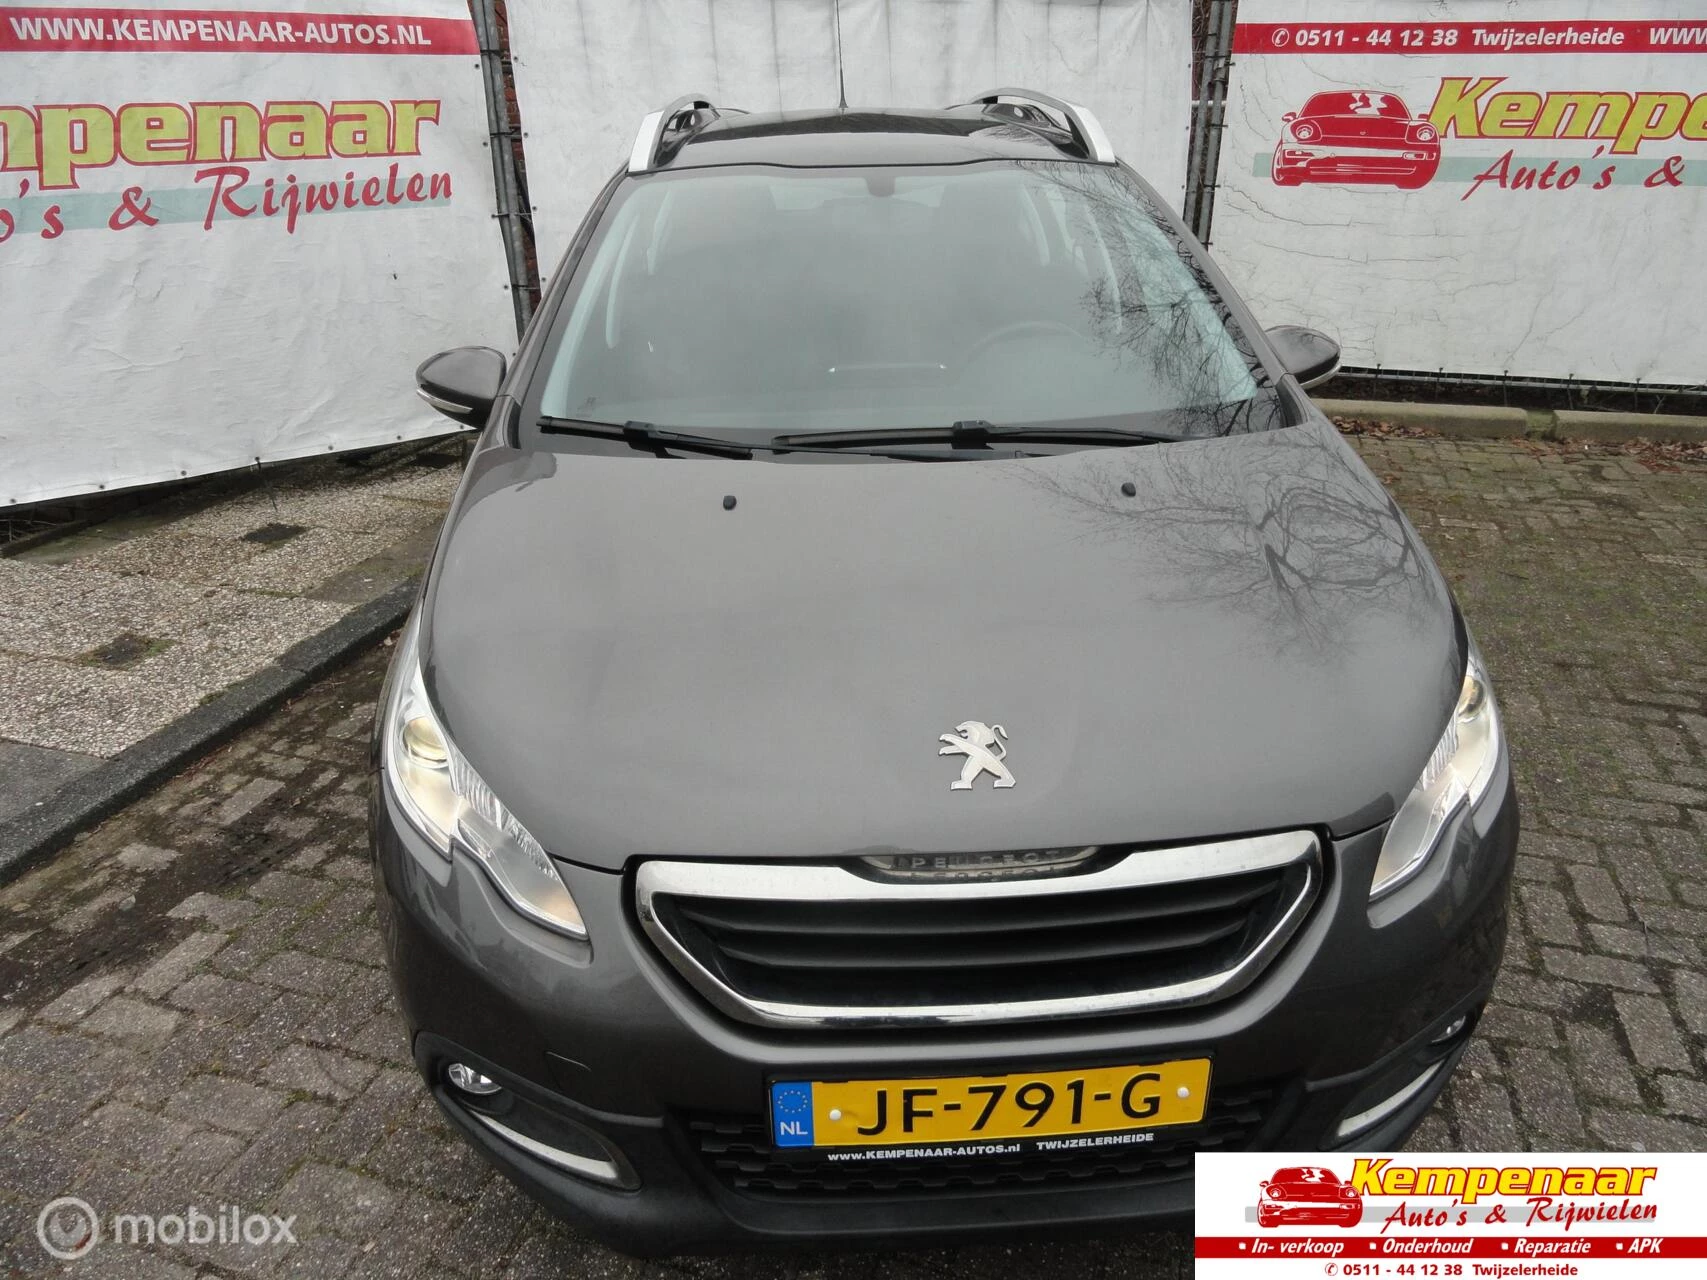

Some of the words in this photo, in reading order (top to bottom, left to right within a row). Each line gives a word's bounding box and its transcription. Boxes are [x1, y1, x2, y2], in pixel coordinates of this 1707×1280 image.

[9, 16, 432, 46] WWW.KEMPENAAR-AUTOS.NL
[1295, 29, 1344, 46] 0511
[1366, 29, 1391, 46] 44
[1401, 29, 1424, 46] 12
[1431, 28, 1458, 46] 38
[1472, 27, 1625, 51] Twijzelerheide
[1461, 145, 1616, 201] Auto's
[1644, 155, 1685, 188] &
[108, 186, 159, 230] &
[194, 162, 453, 234] Rijwielen
[857, 1072, 1162, 1136] JF-791-G
[780, 1121, 808, 1136] NL
[827, 1143, 1021, 1162] www.KEMPENAAR-AUTOS.nl
[1036, 1132, 1155, 1151] TWIJZELERHEIDE
